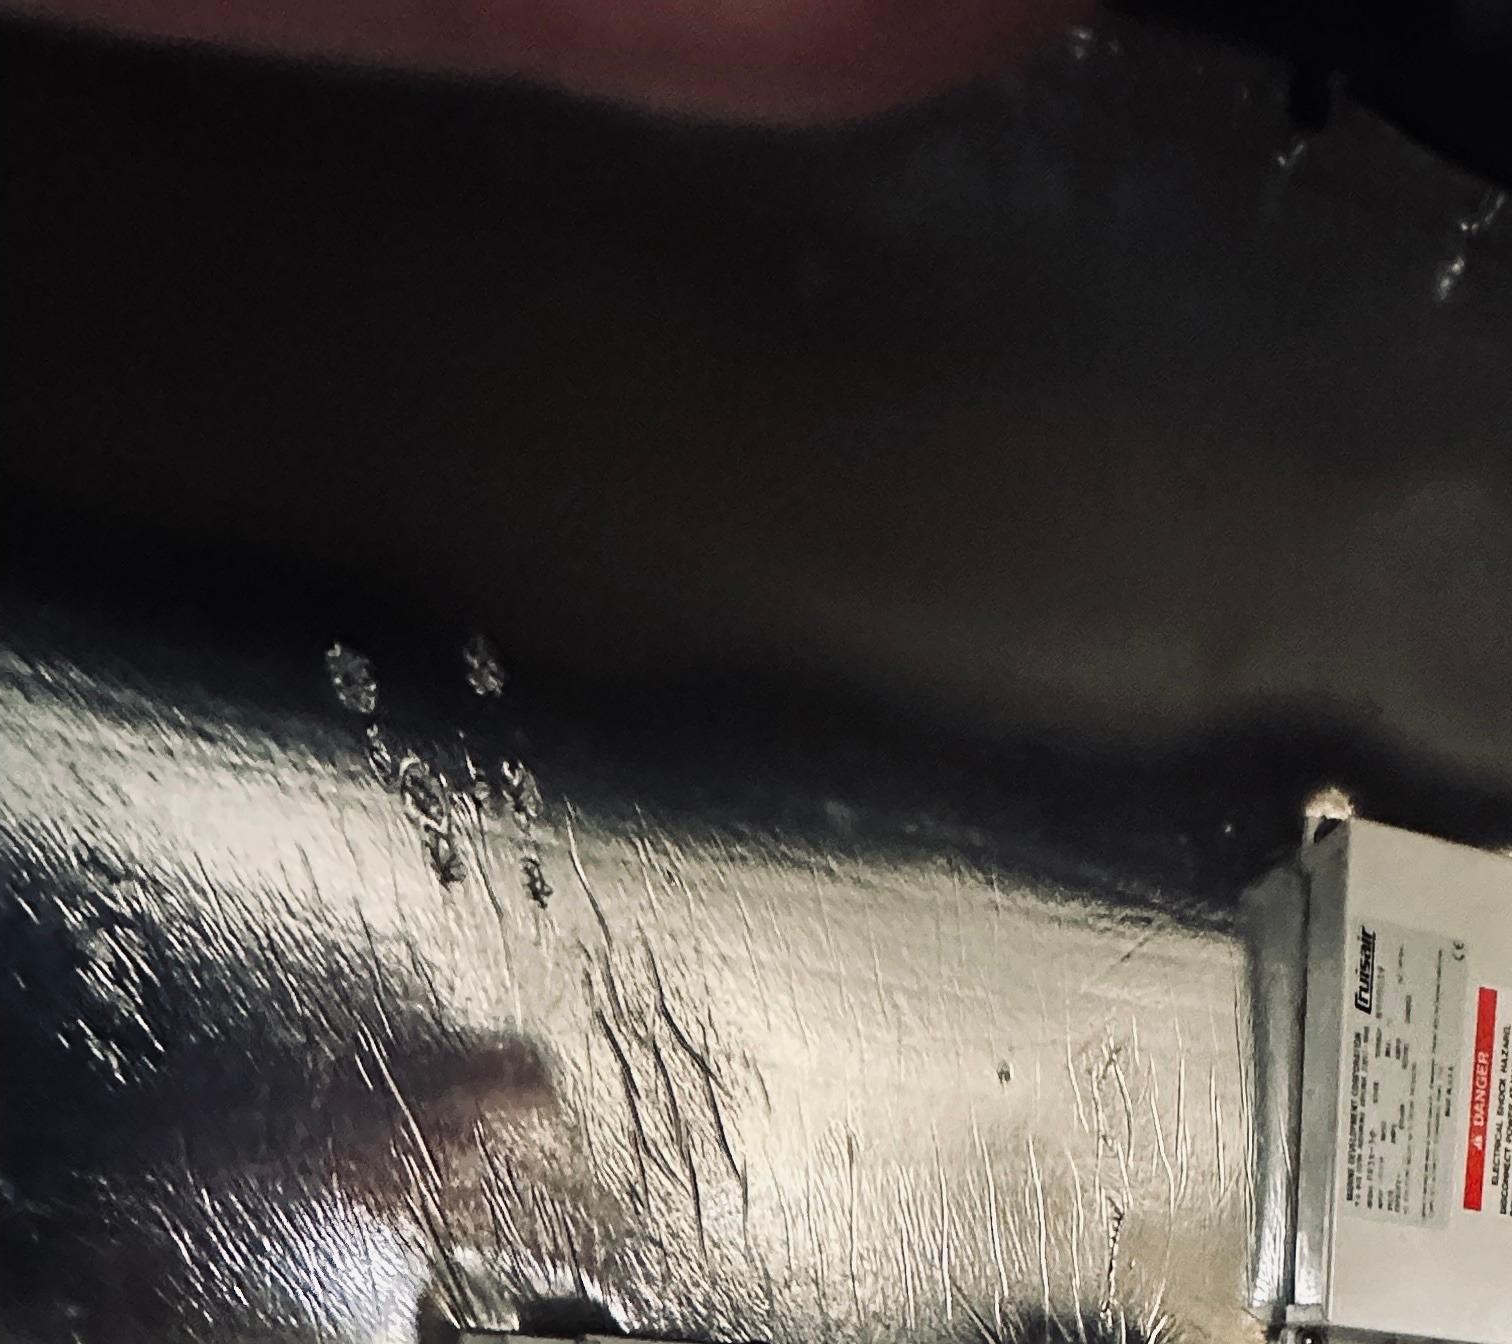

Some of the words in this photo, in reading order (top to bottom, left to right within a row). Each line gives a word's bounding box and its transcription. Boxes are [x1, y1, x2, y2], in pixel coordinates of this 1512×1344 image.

[1473, 1051, 1489, 1126] DANGER
[1496, 1079, 1506, 1116] SHOCK
[1491, 1120, 1503, 1185] ELECTRICAL
[1500, 1148, 1511, 1214] DISCONNECT
